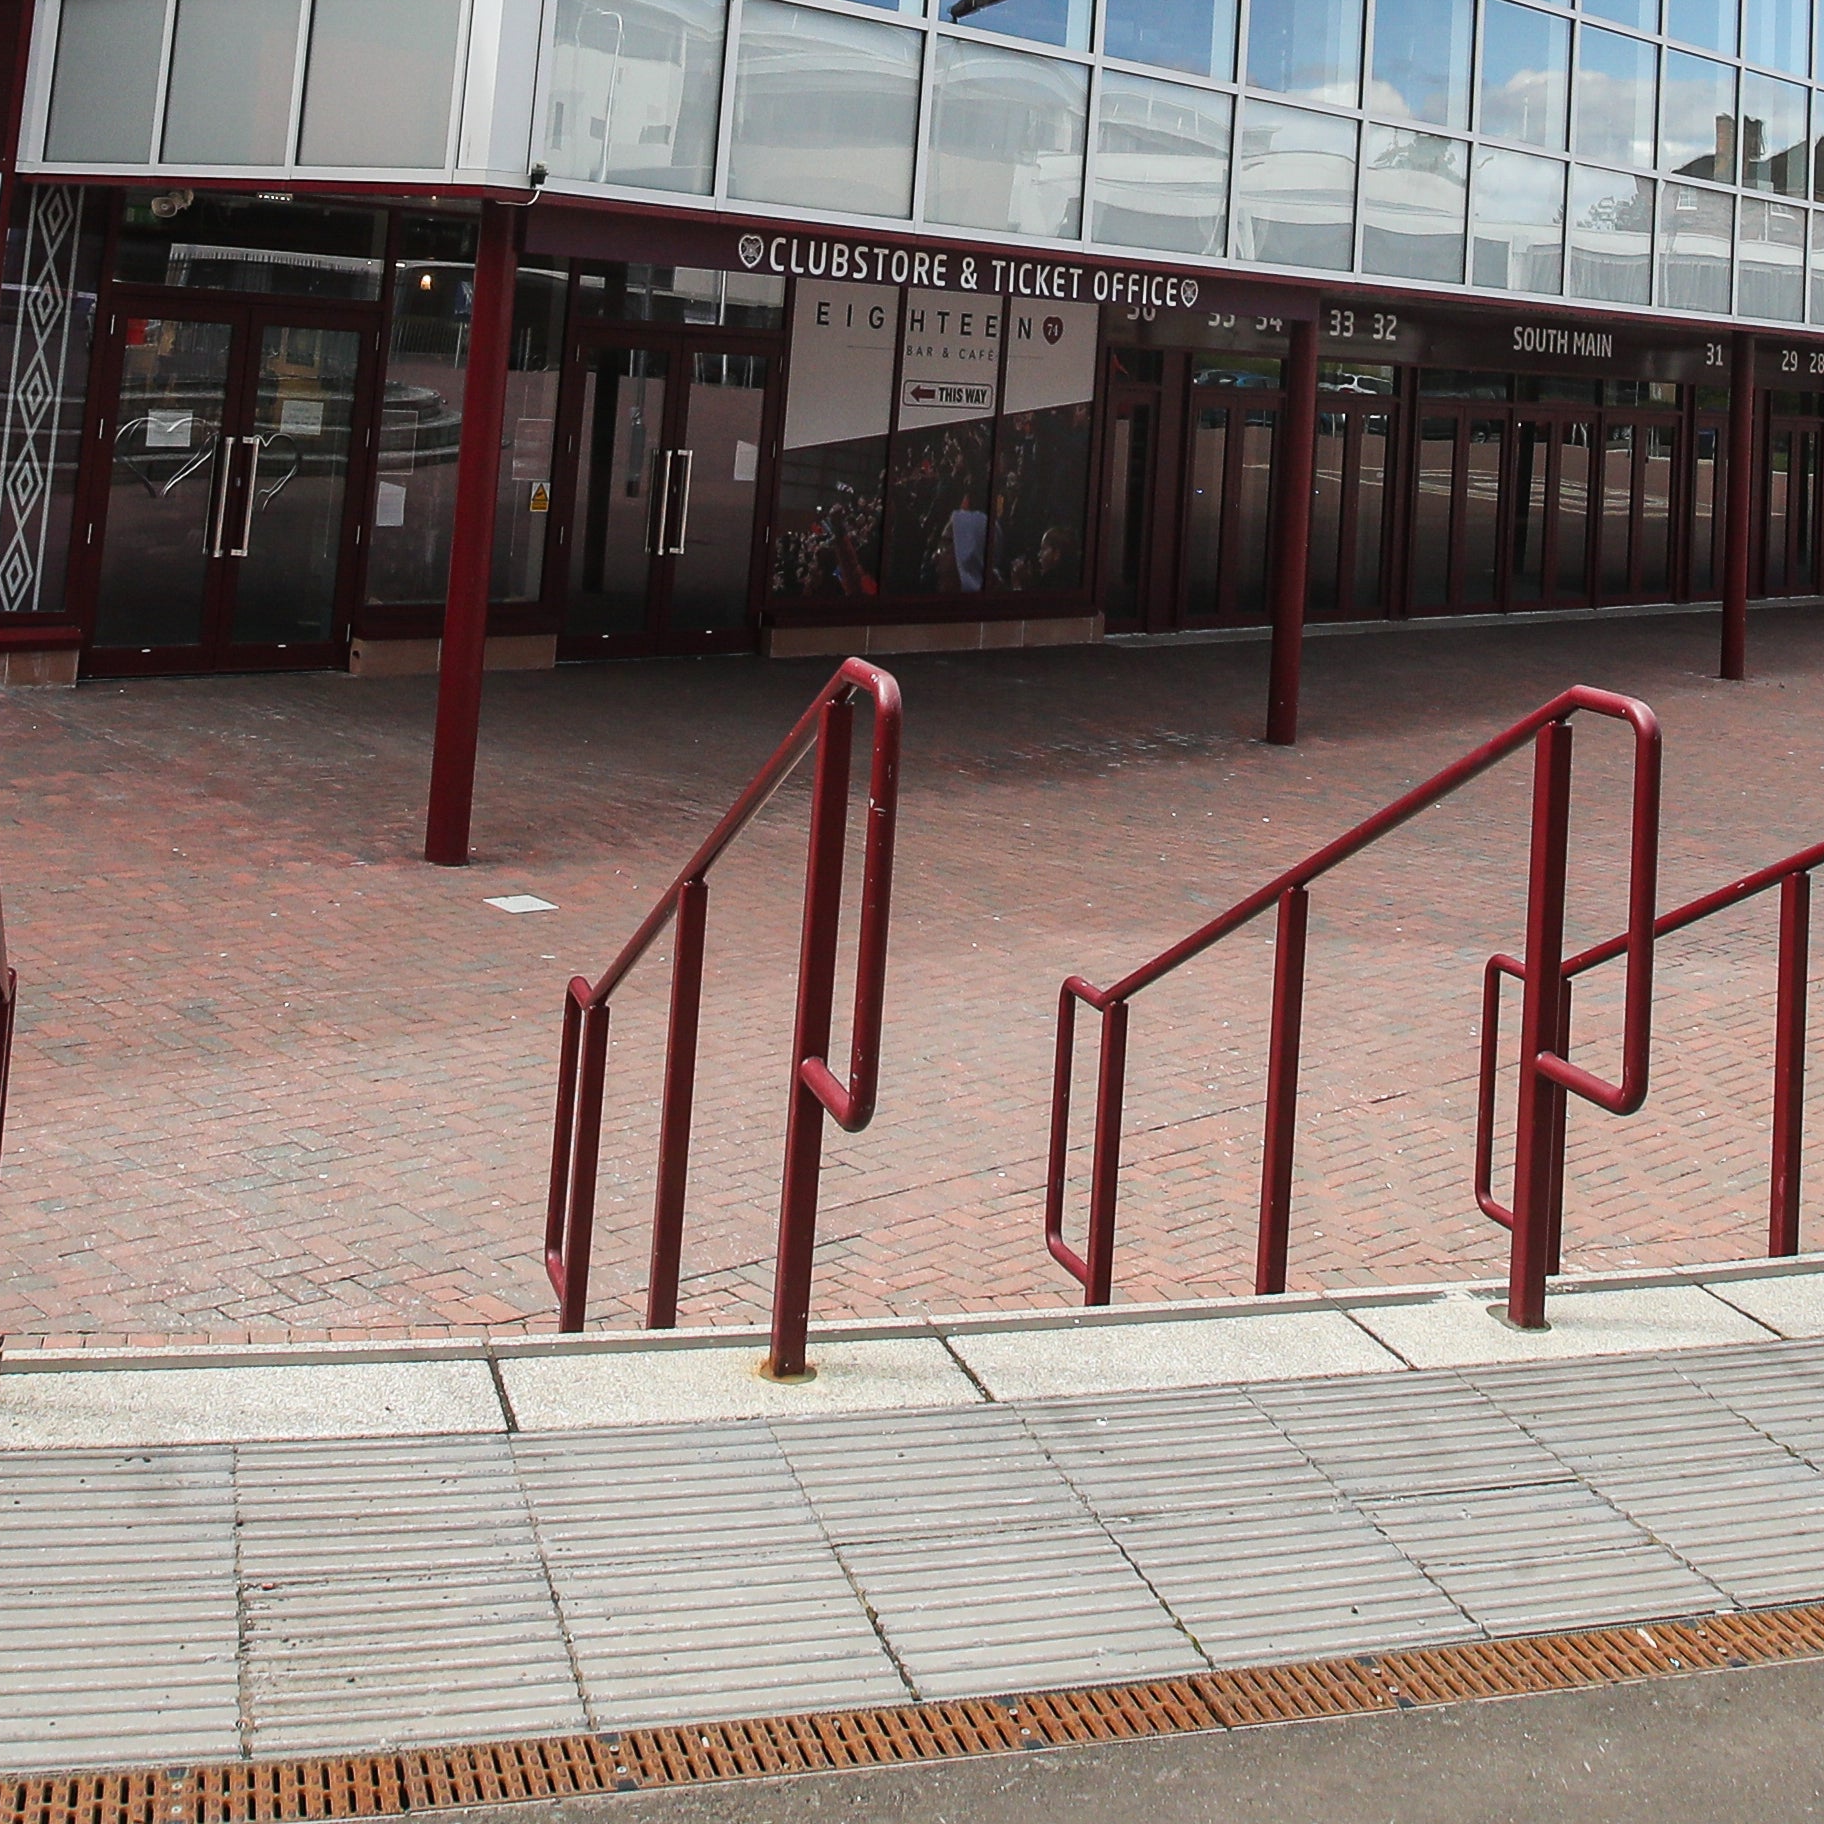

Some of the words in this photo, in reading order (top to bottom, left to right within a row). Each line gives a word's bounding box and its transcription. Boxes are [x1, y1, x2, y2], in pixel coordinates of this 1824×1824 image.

[769, 236, 948, 288] CLUBSTORE
[959, 256, 978, 290] &
[991, 259, 1083, 300] TICKET
[1093, 270, 1178, 308] OFFICE
[816, 301, 1033, 341] EIGHTEEN
[1329, 309, 1355, 338] 33
[1372, 313, 1398, 342] 32
[906, 345, 933, 358] BAR
[942, 347, 950, 359] &
[1512, 325, 1568, 357] SOUTH
[1573, 329, 1614, 359] MAIN
[1705, 343, 1725, 368] 31
[1781, 350, 1798, 372] 29
[938, 387, 965, 403] THIS
[965, 389, 988, 405] WAY
